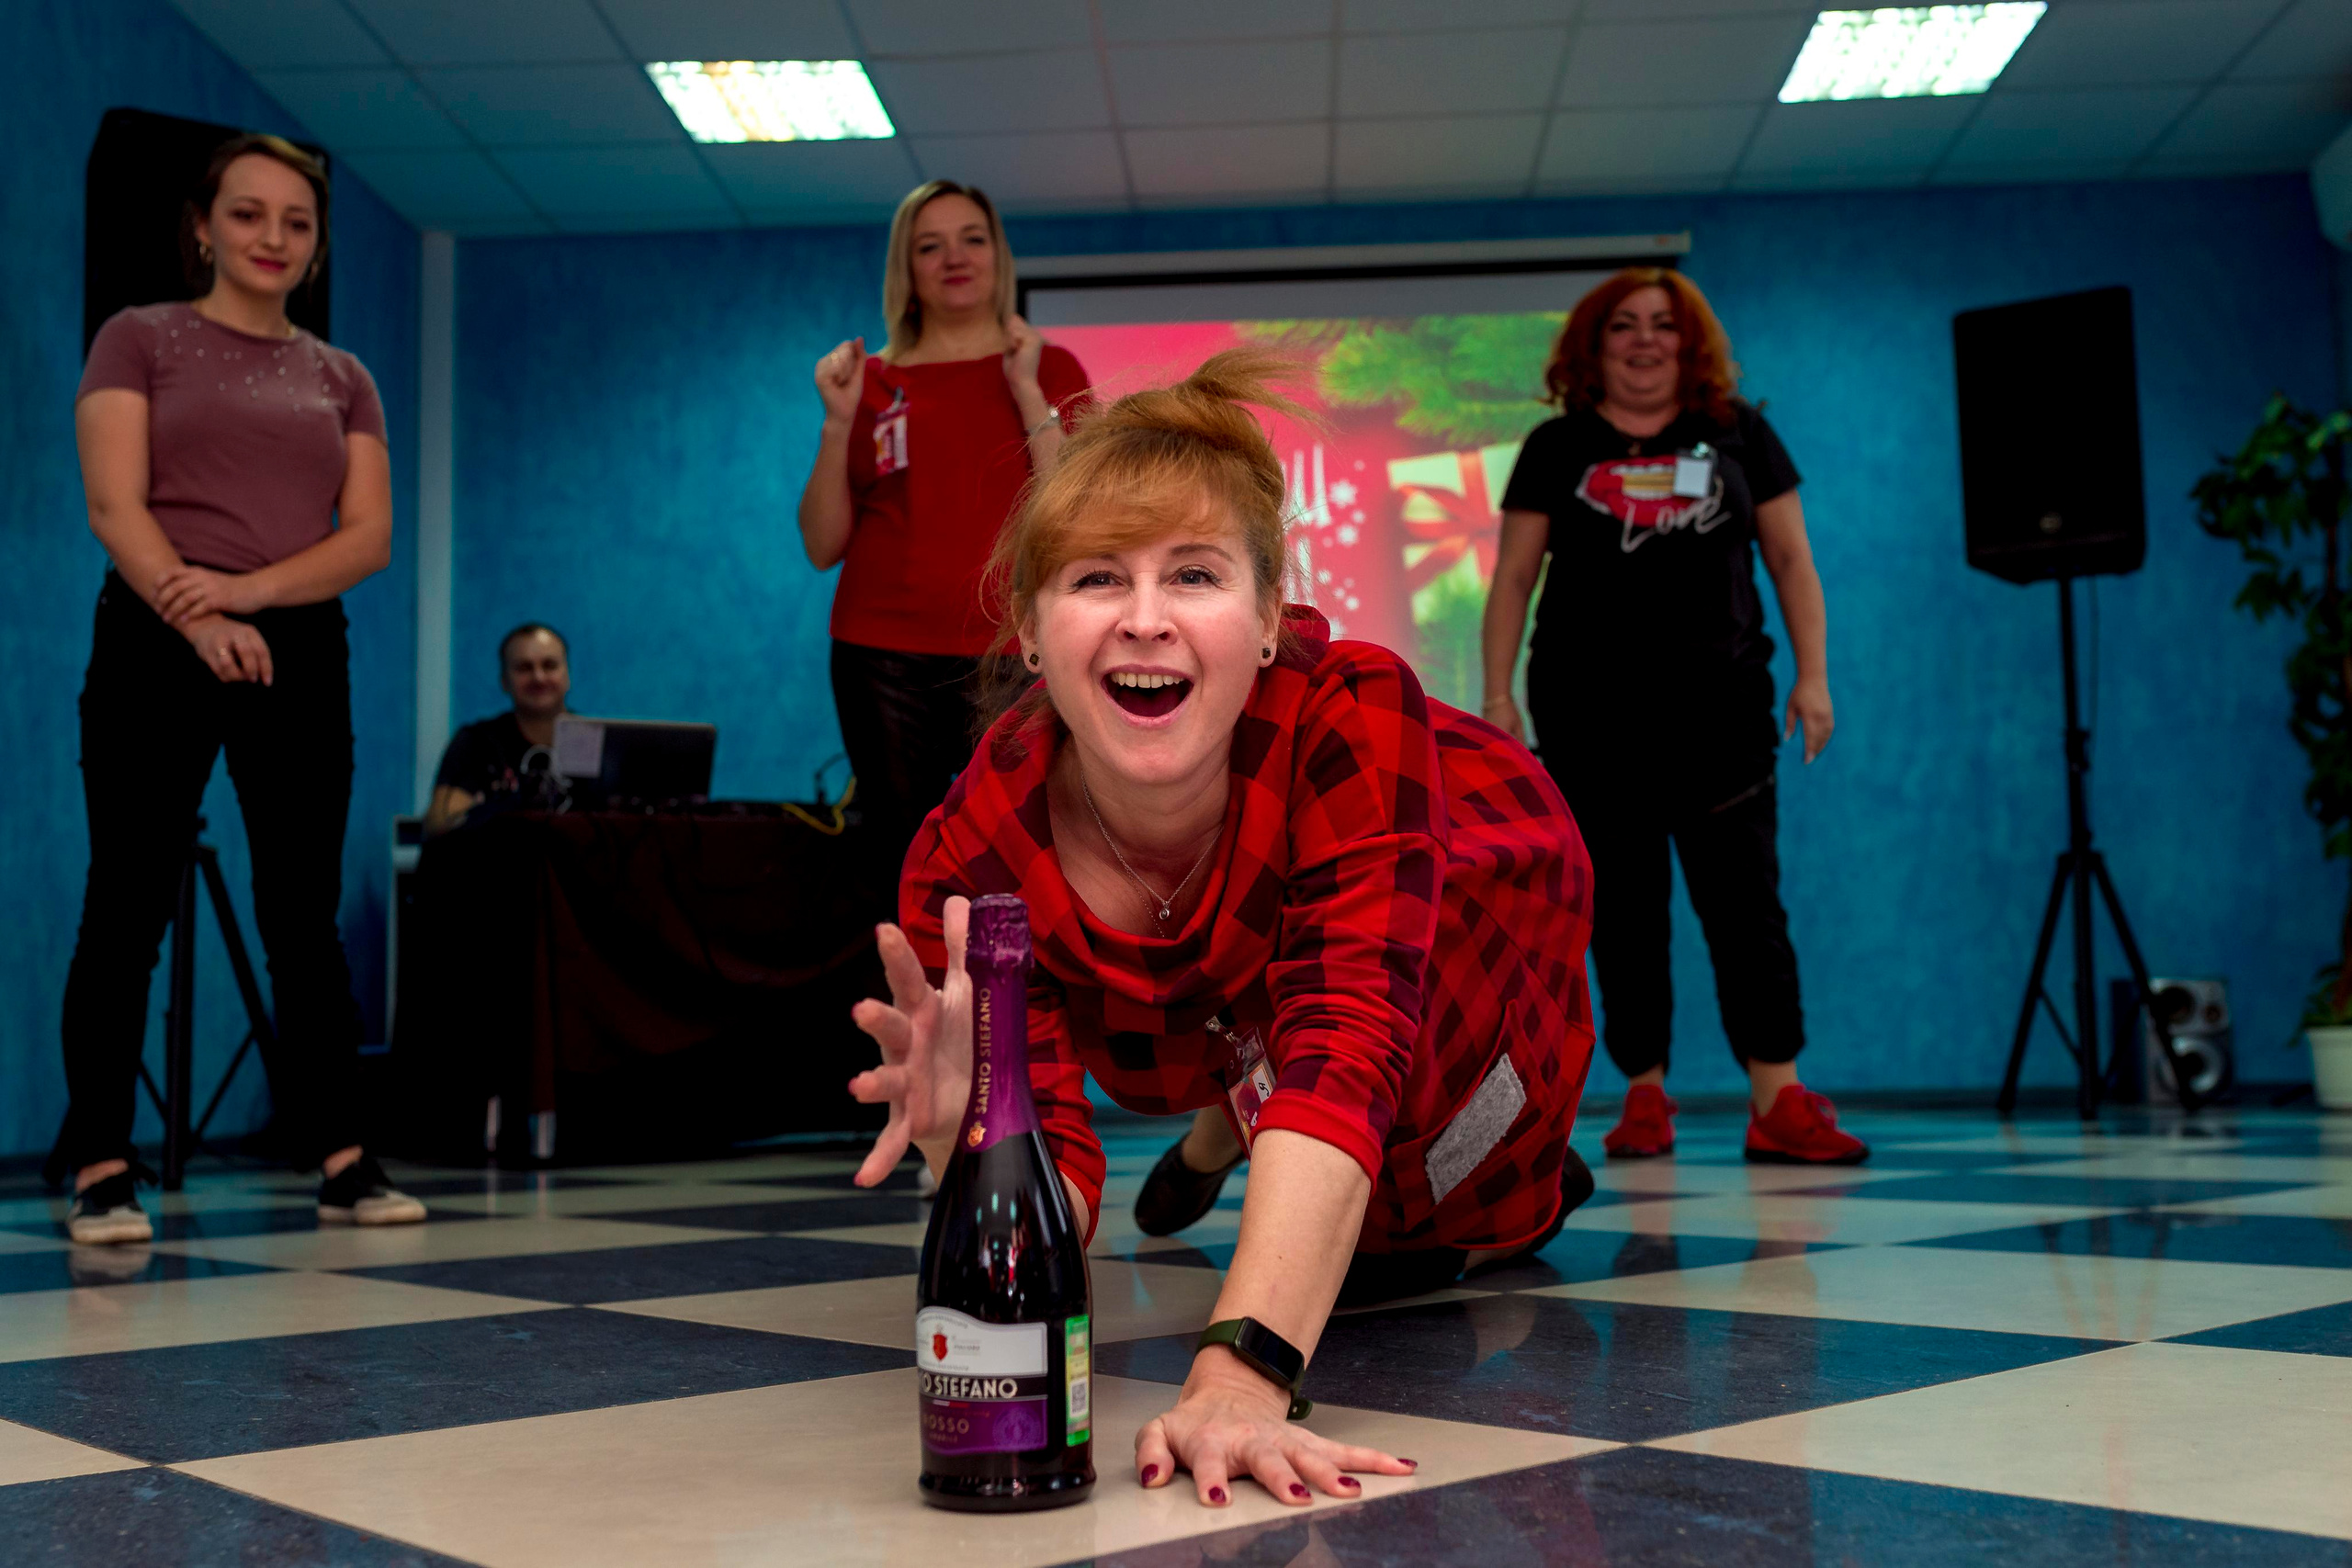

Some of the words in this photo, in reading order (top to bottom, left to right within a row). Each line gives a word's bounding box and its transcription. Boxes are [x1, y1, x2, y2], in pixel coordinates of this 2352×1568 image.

[1621, 497, 1733, 553] Love
[978, 987, 992, 1058] STEFANO
[975, 1061, 992, 1115] SANTO
[933, 1374, 1018, 1399] STEFANO
